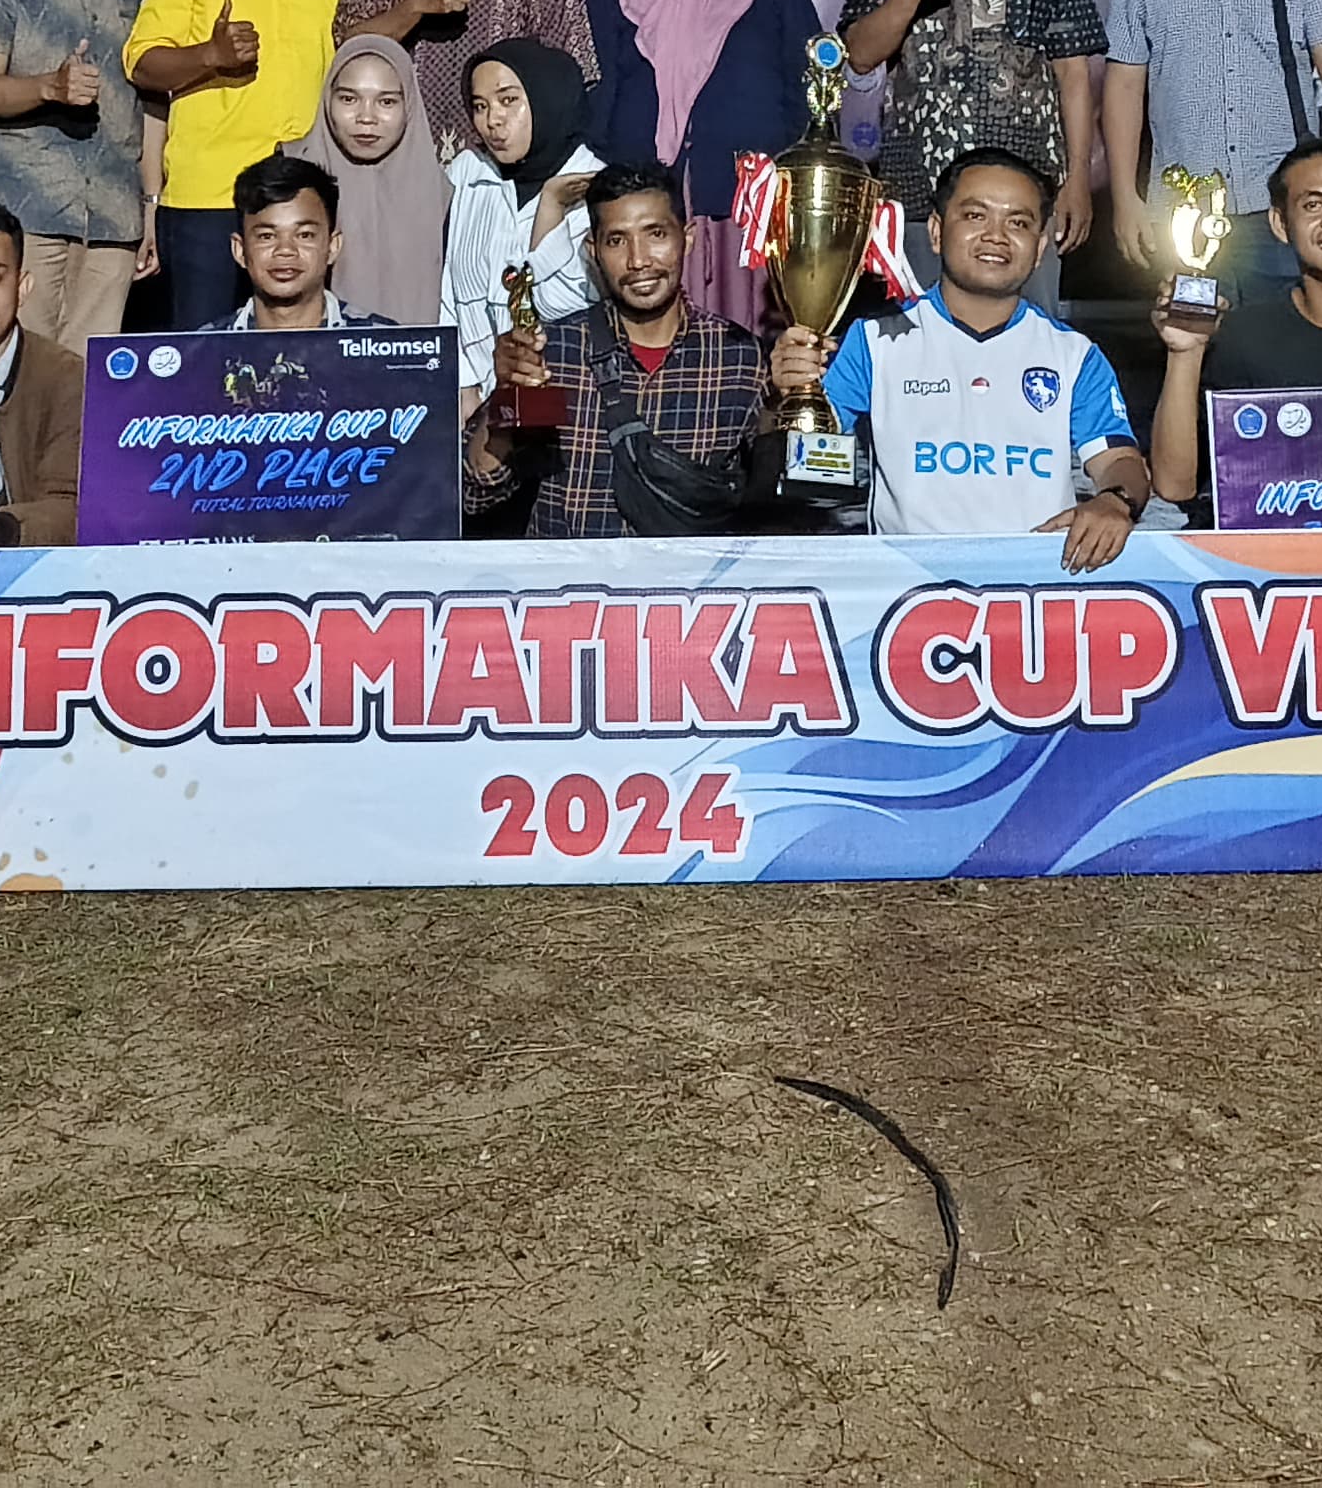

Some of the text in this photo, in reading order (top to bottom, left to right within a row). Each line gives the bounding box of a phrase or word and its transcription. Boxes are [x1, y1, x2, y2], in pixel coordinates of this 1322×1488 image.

[339, 336, 441, 358] Telkomsel
[119, 404, 428, 448] INFORMATIKA CUP VI
[149, 445, 396, 499] 2ND PLACE
[915, 441, 1053, 479] BOR FC
[191, 492, 351, 515] FUTSAL TOURNAMENT
[881, 588, 1177, 728] CUP
[481, 772, 745, 857] 2024
